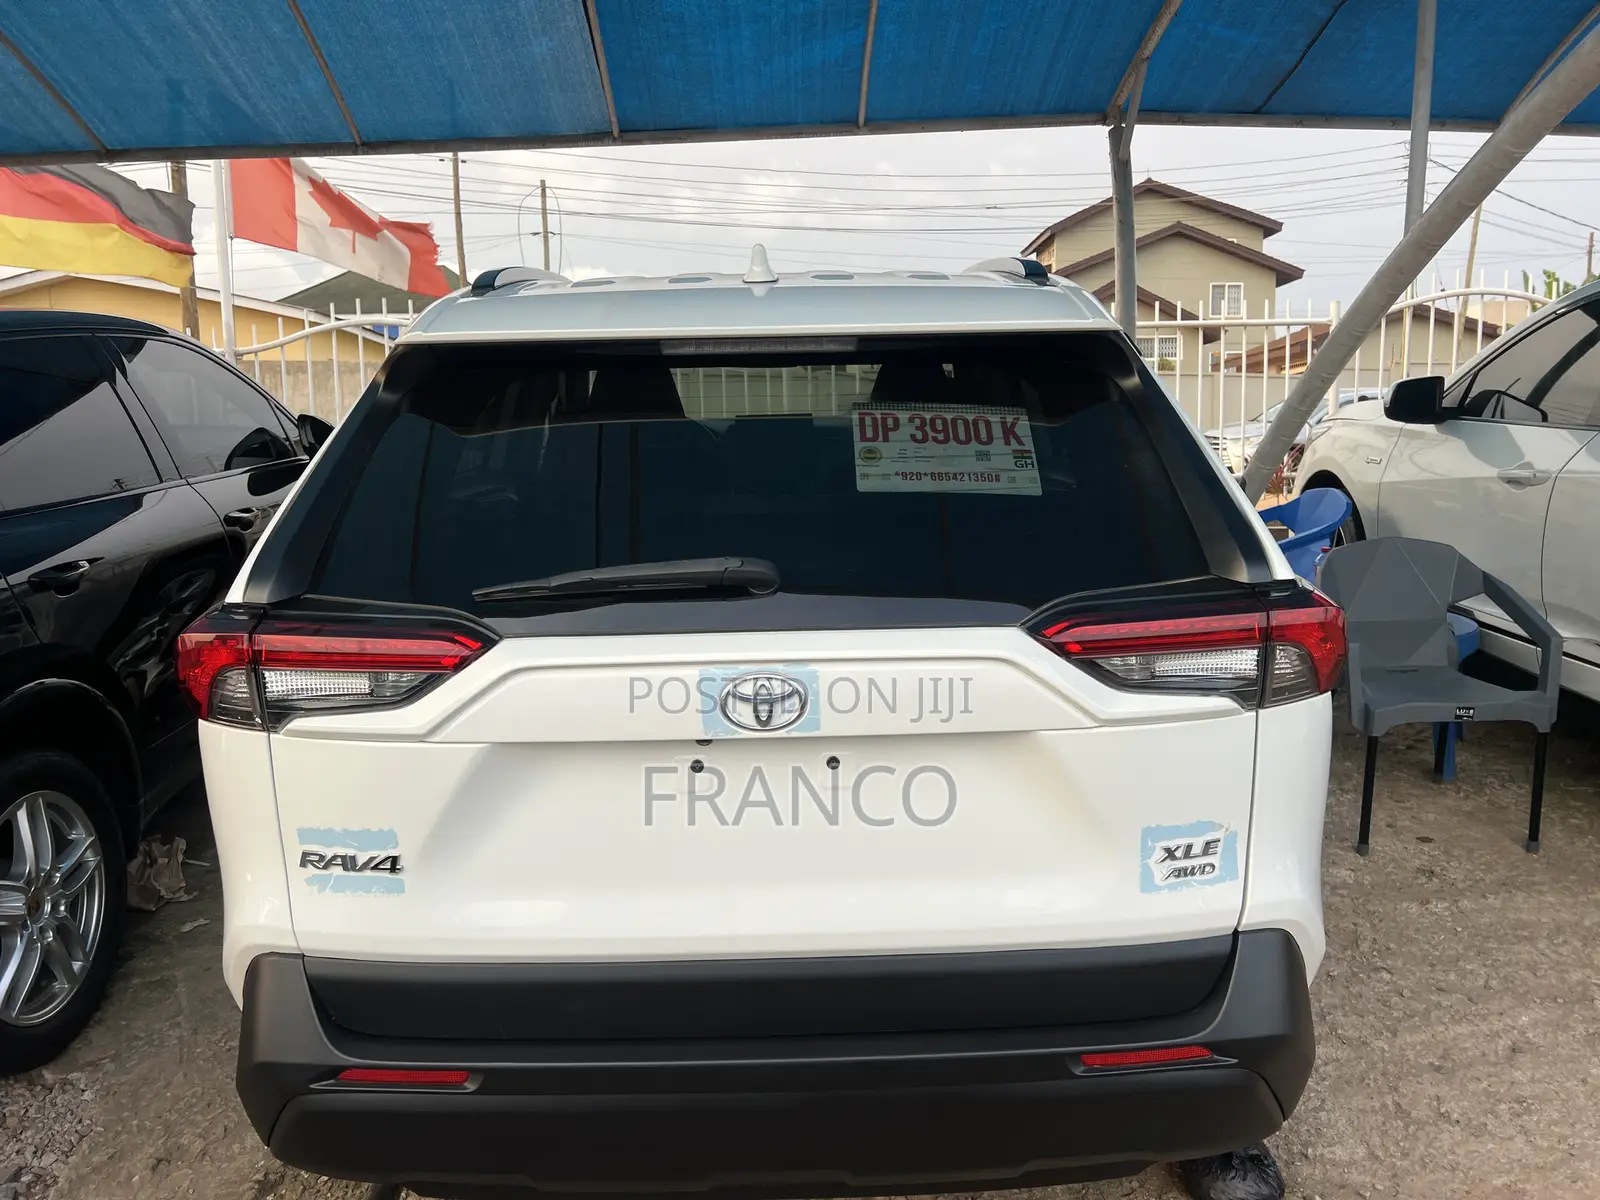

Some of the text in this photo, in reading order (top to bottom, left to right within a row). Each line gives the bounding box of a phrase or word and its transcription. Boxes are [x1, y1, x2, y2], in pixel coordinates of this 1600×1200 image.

[858, 411, 1026, 447] DP 3900 K
[1014, 459, 1036, 469] GH
[298, 849, 404, 875] RAV4
[1155, 837, 1221, 864] XLE
[1161, 862, 1217, 881] AWD
